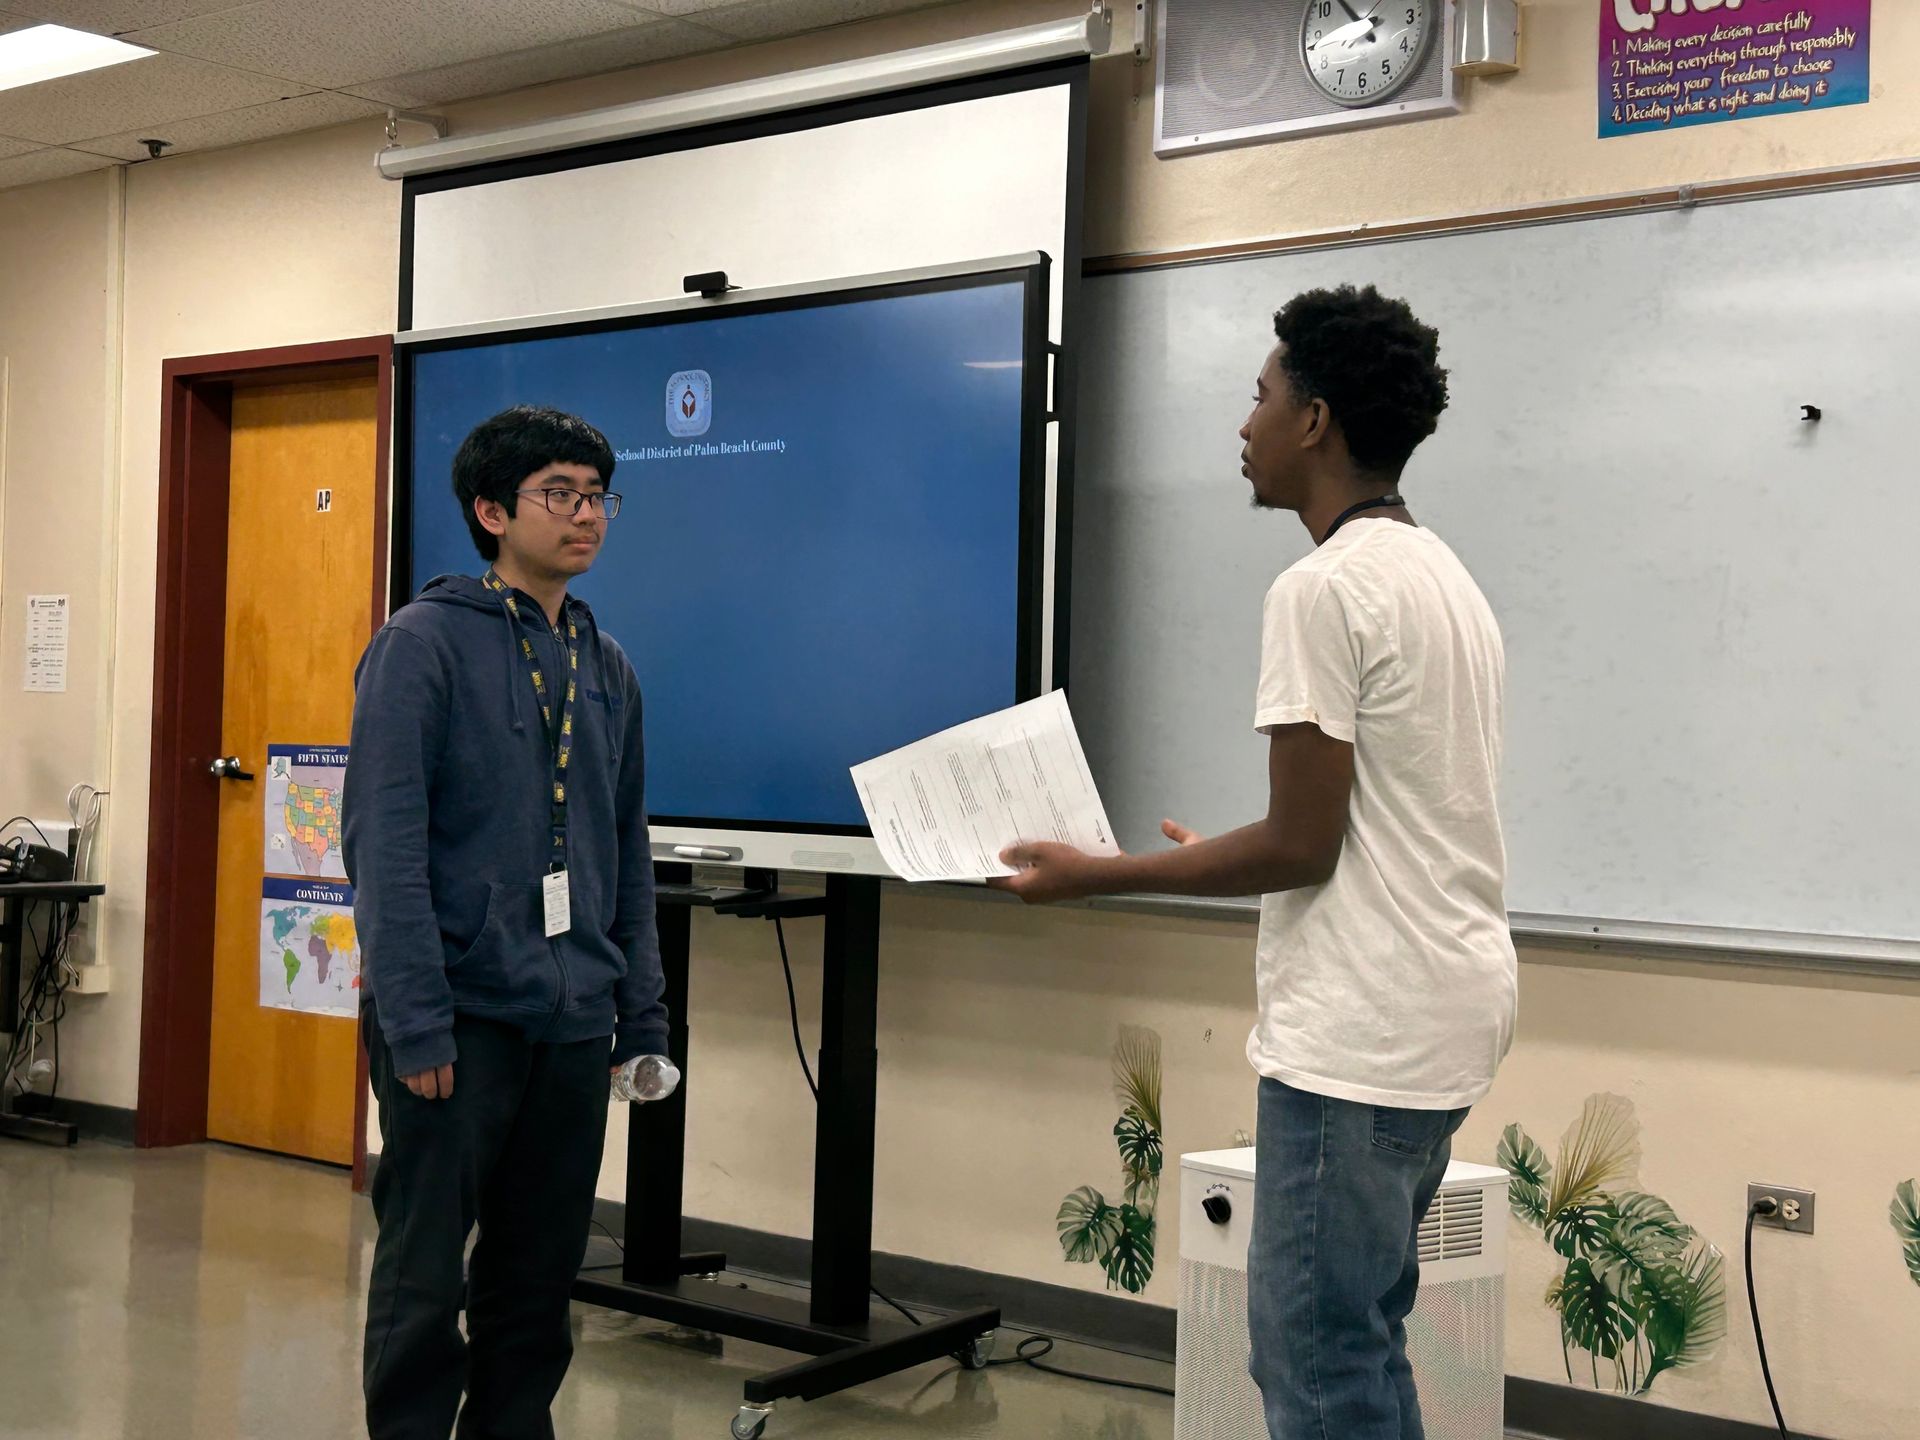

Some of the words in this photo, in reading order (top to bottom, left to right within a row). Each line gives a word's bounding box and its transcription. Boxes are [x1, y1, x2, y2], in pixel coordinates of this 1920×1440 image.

[1318, 0, 1331, 18] 10
[1405, 8, 1415, 25] 3
[1612, 38, 1620, 55] 1.
[1626, 37, 1671, 56] Making
[1675, 33, 1707, 47] every
[1710, 24, 1754, 42] decision
[1757, 11, 1812, 35] carefully
[1399, 36, 1409, 53] 4
[1611, 60, 1623, 78] 2.
[1626, 58, 1674, 79] Thinking
[1676, 47, 1737, 70] everything
[1740, 37, 1787, 62] through
[1790, 27, 1856, 56] responsibly
[1320, 54, 1329, 70] 8
[1381, 59, 1391, 75] 5
[1336, 68, 1345, 86] 7
[1358, 72, 1367, 89] 6
[1611, 82, 1622, 100] 3.
[1626, 80, 1681, 100] Exercising
[1683, 77, 1713, 95] your
[1719, 64, 1770, 89] freedom
[1774, 63, 1789, 78] to
[1792, 57, 1834, 75] choose
[1611, 104, 1622, 122] 4.
[1625, 101, 1671, 124] Deciding
[1673, 95, 1706, 116] what
[1708, 97, 1717, 111] is
[1720, 89, 1749, 114] right
[1752, 82, 1777, 103] and
[1778, 81, 1811, 105] doing
[1815, 79, 1828, 96] it
[615, 447, 645, 462] School
[647, 446, 682, 460] District
[683, 443, 694, 457] of
[694, 442, 719, 456] Palm
[720, 439, 750, 454] Beach
[751, 438, 786, 454] County
[317, 490, 331, 511] AP
[298, 753, 319, 763] FIFTY
[321, 753, 349, 764] STATES
[296, 888, 344, 903] CONTINENTS
